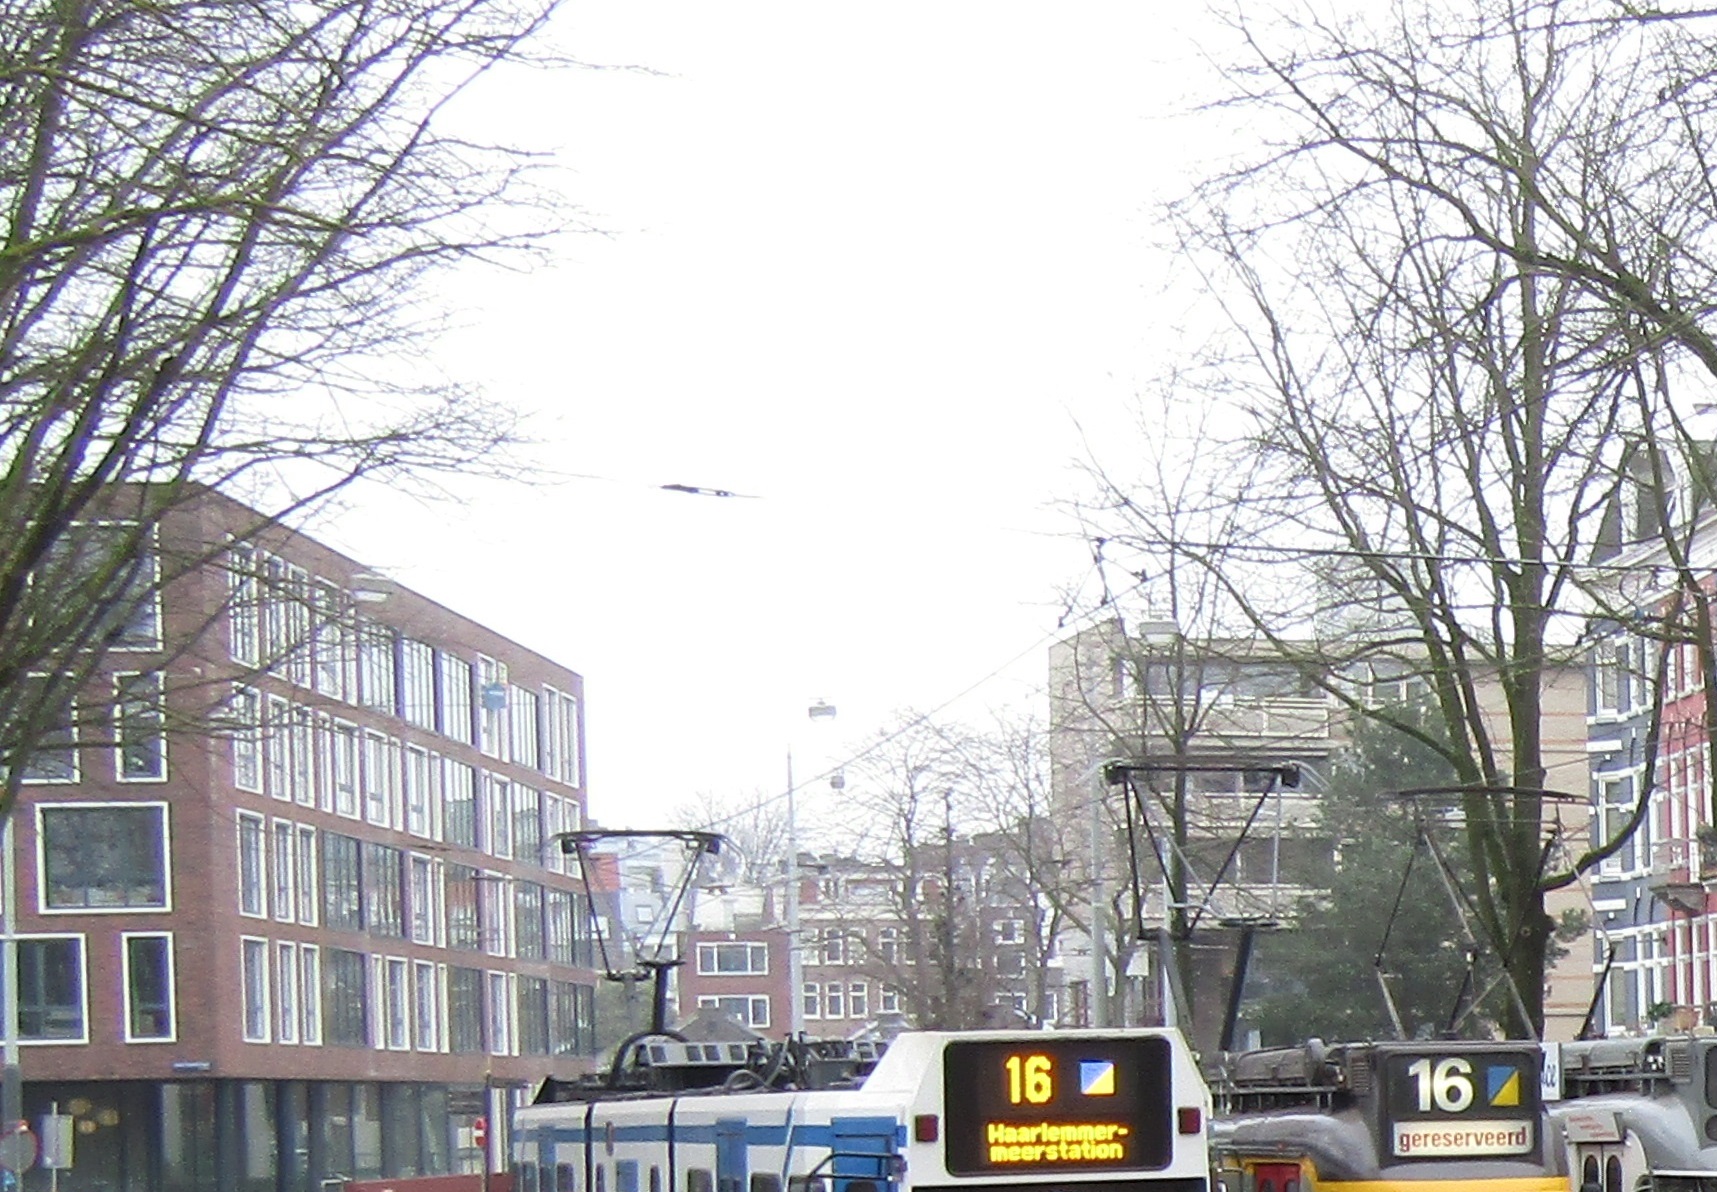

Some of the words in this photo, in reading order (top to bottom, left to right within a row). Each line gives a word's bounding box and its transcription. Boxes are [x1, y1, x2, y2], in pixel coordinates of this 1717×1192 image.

[1006, 1055, 1053, 1104] 16
[1408, 1057, 1474, 1113] 16
[987, 1122, 1129, 1144] Haarlemmer-
[1400, 1126, 1527, 1152] gereserveerd
[989, 1140, 1123, 1162] meerstation
